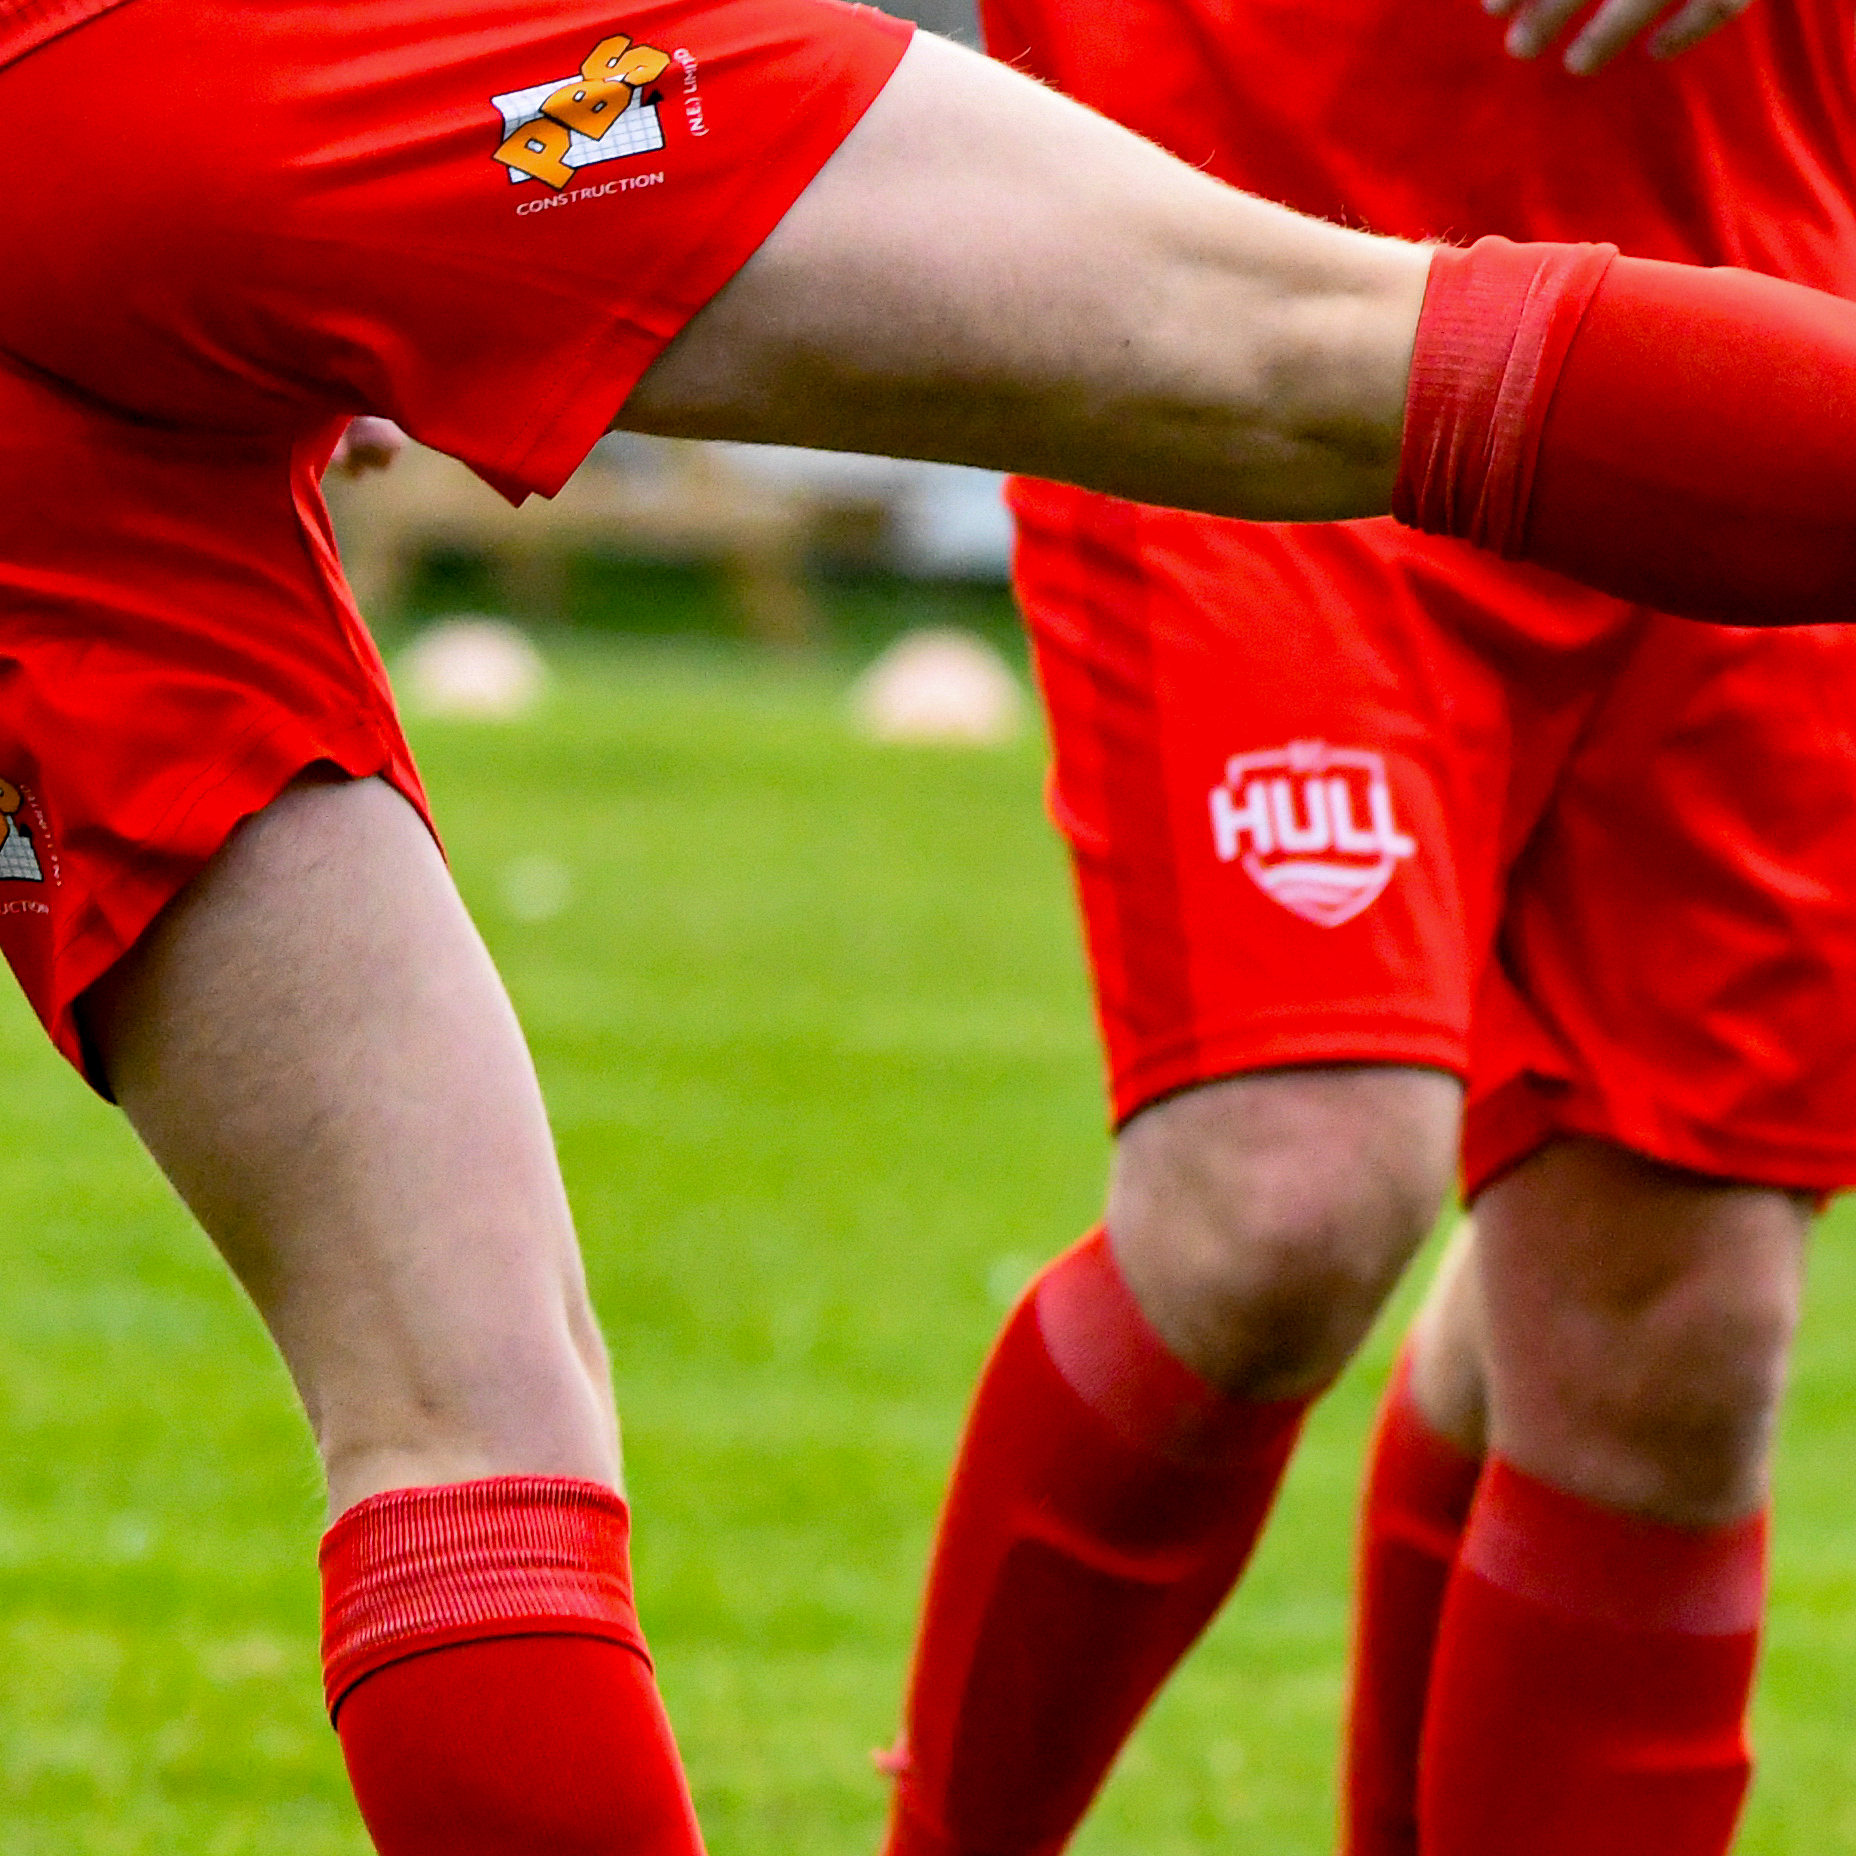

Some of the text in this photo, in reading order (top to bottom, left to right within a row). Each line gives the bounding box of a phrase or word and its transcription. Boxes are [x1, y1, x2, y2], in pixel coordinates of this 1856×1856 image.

[491, 32, 672, 192] PBS
[516, 171, 665, 216] CONSTRUCTION
[1208, 780, 1417, 863] HULL
